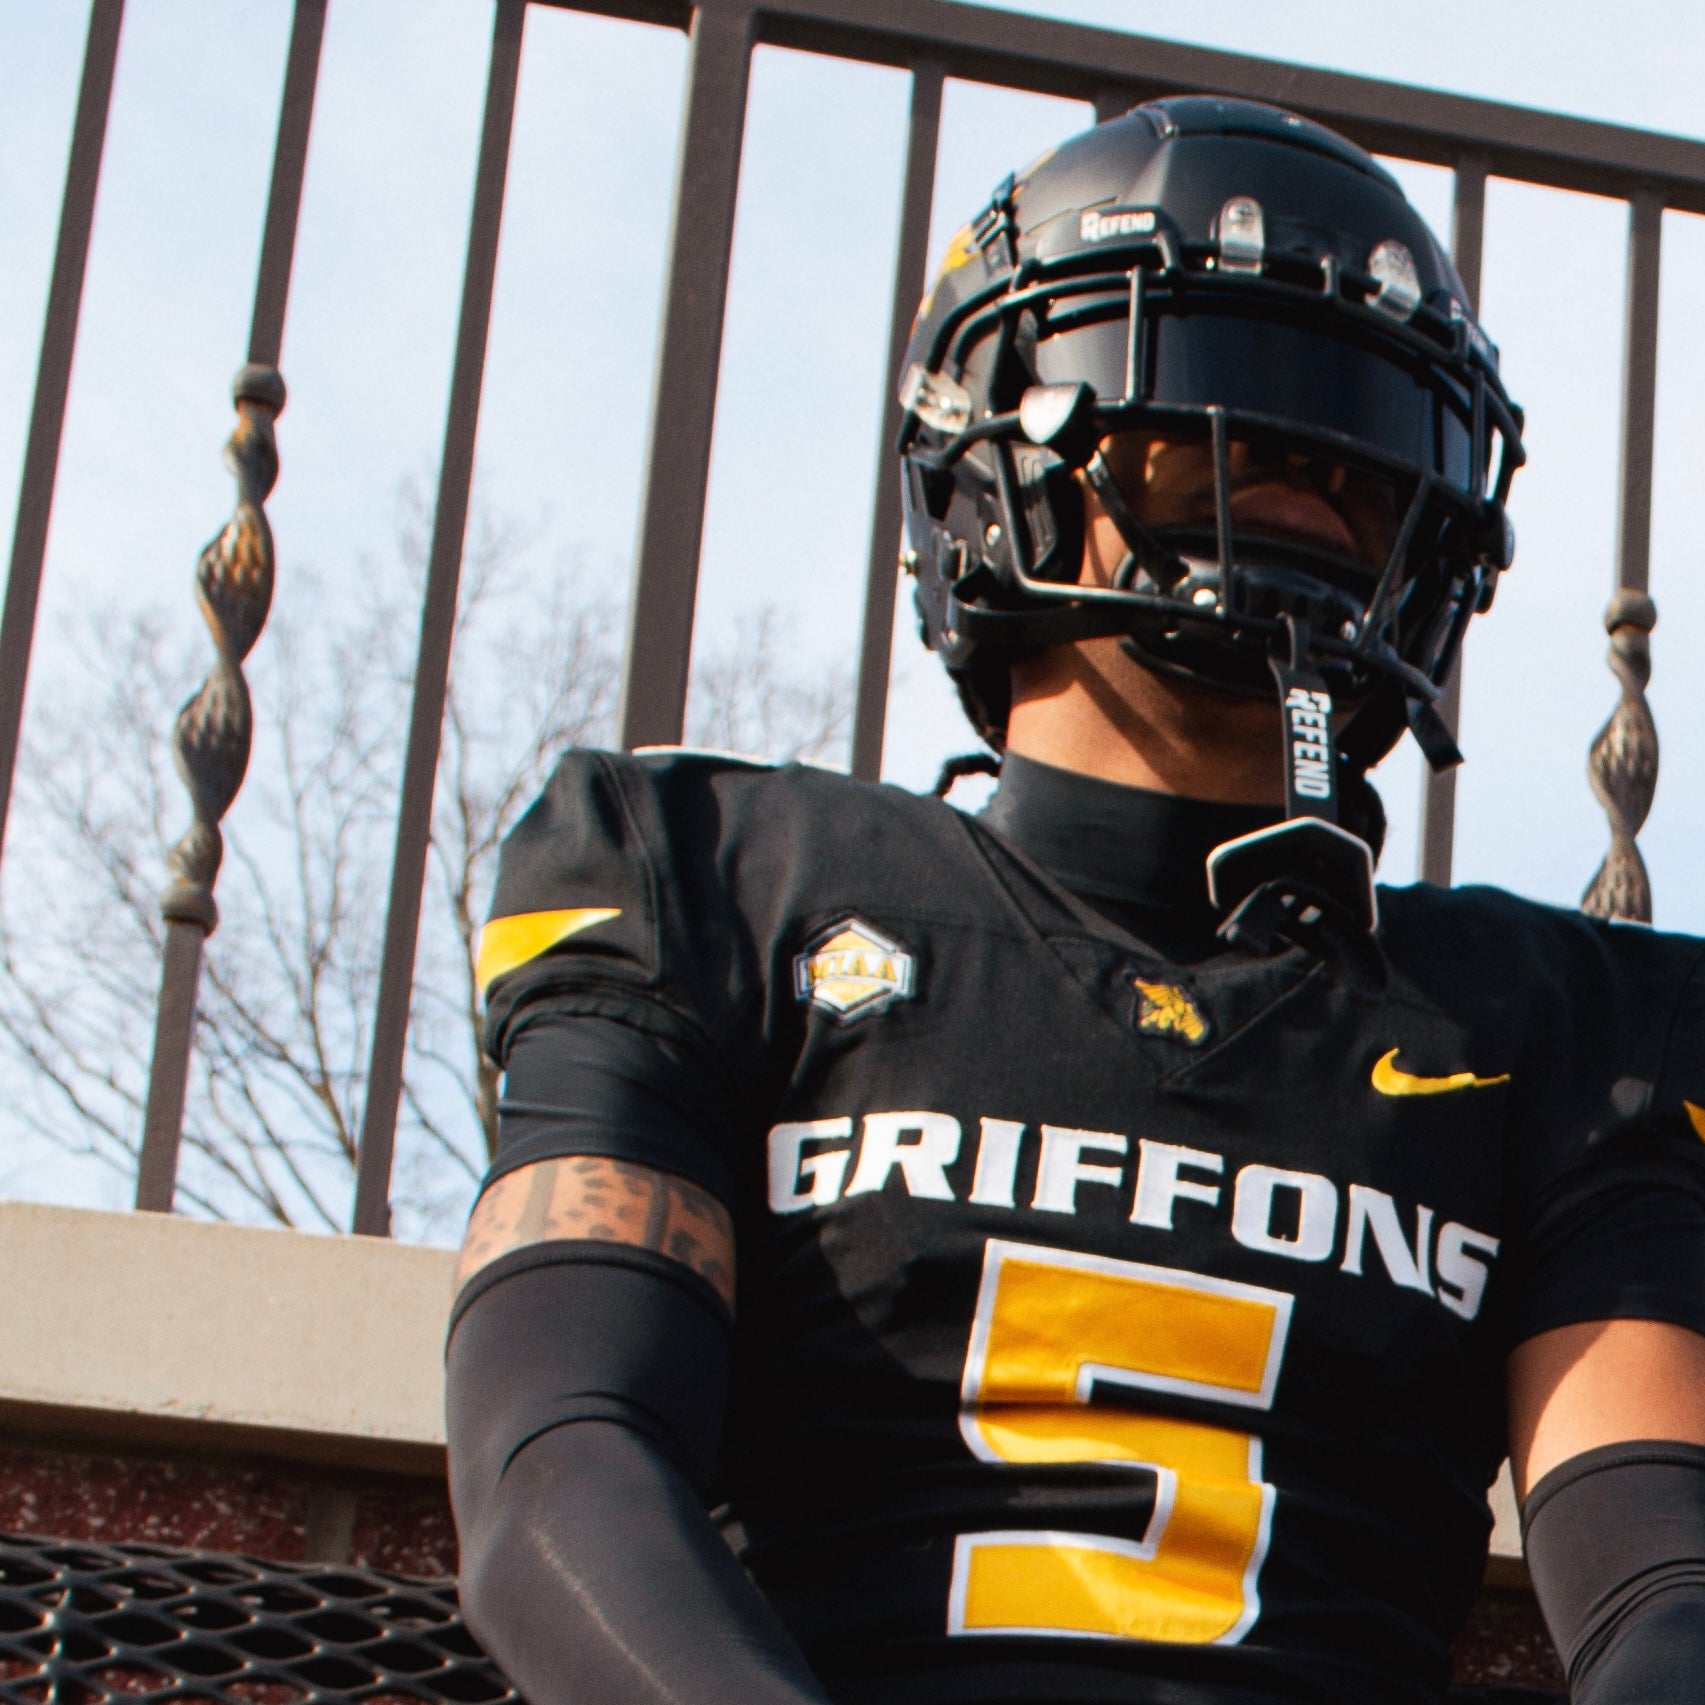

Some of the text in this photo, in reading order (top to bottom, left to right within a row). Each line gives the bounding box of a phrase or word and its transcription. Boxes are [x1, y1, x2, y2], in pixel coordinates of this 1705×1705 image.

[1285, 688, 1332, 799] REFEND
[807, 951, 899, 987] MIAA
[767, 1110, 1501, 1322] GRIFFONS
[946, 1237, 1295, 1647] 5
